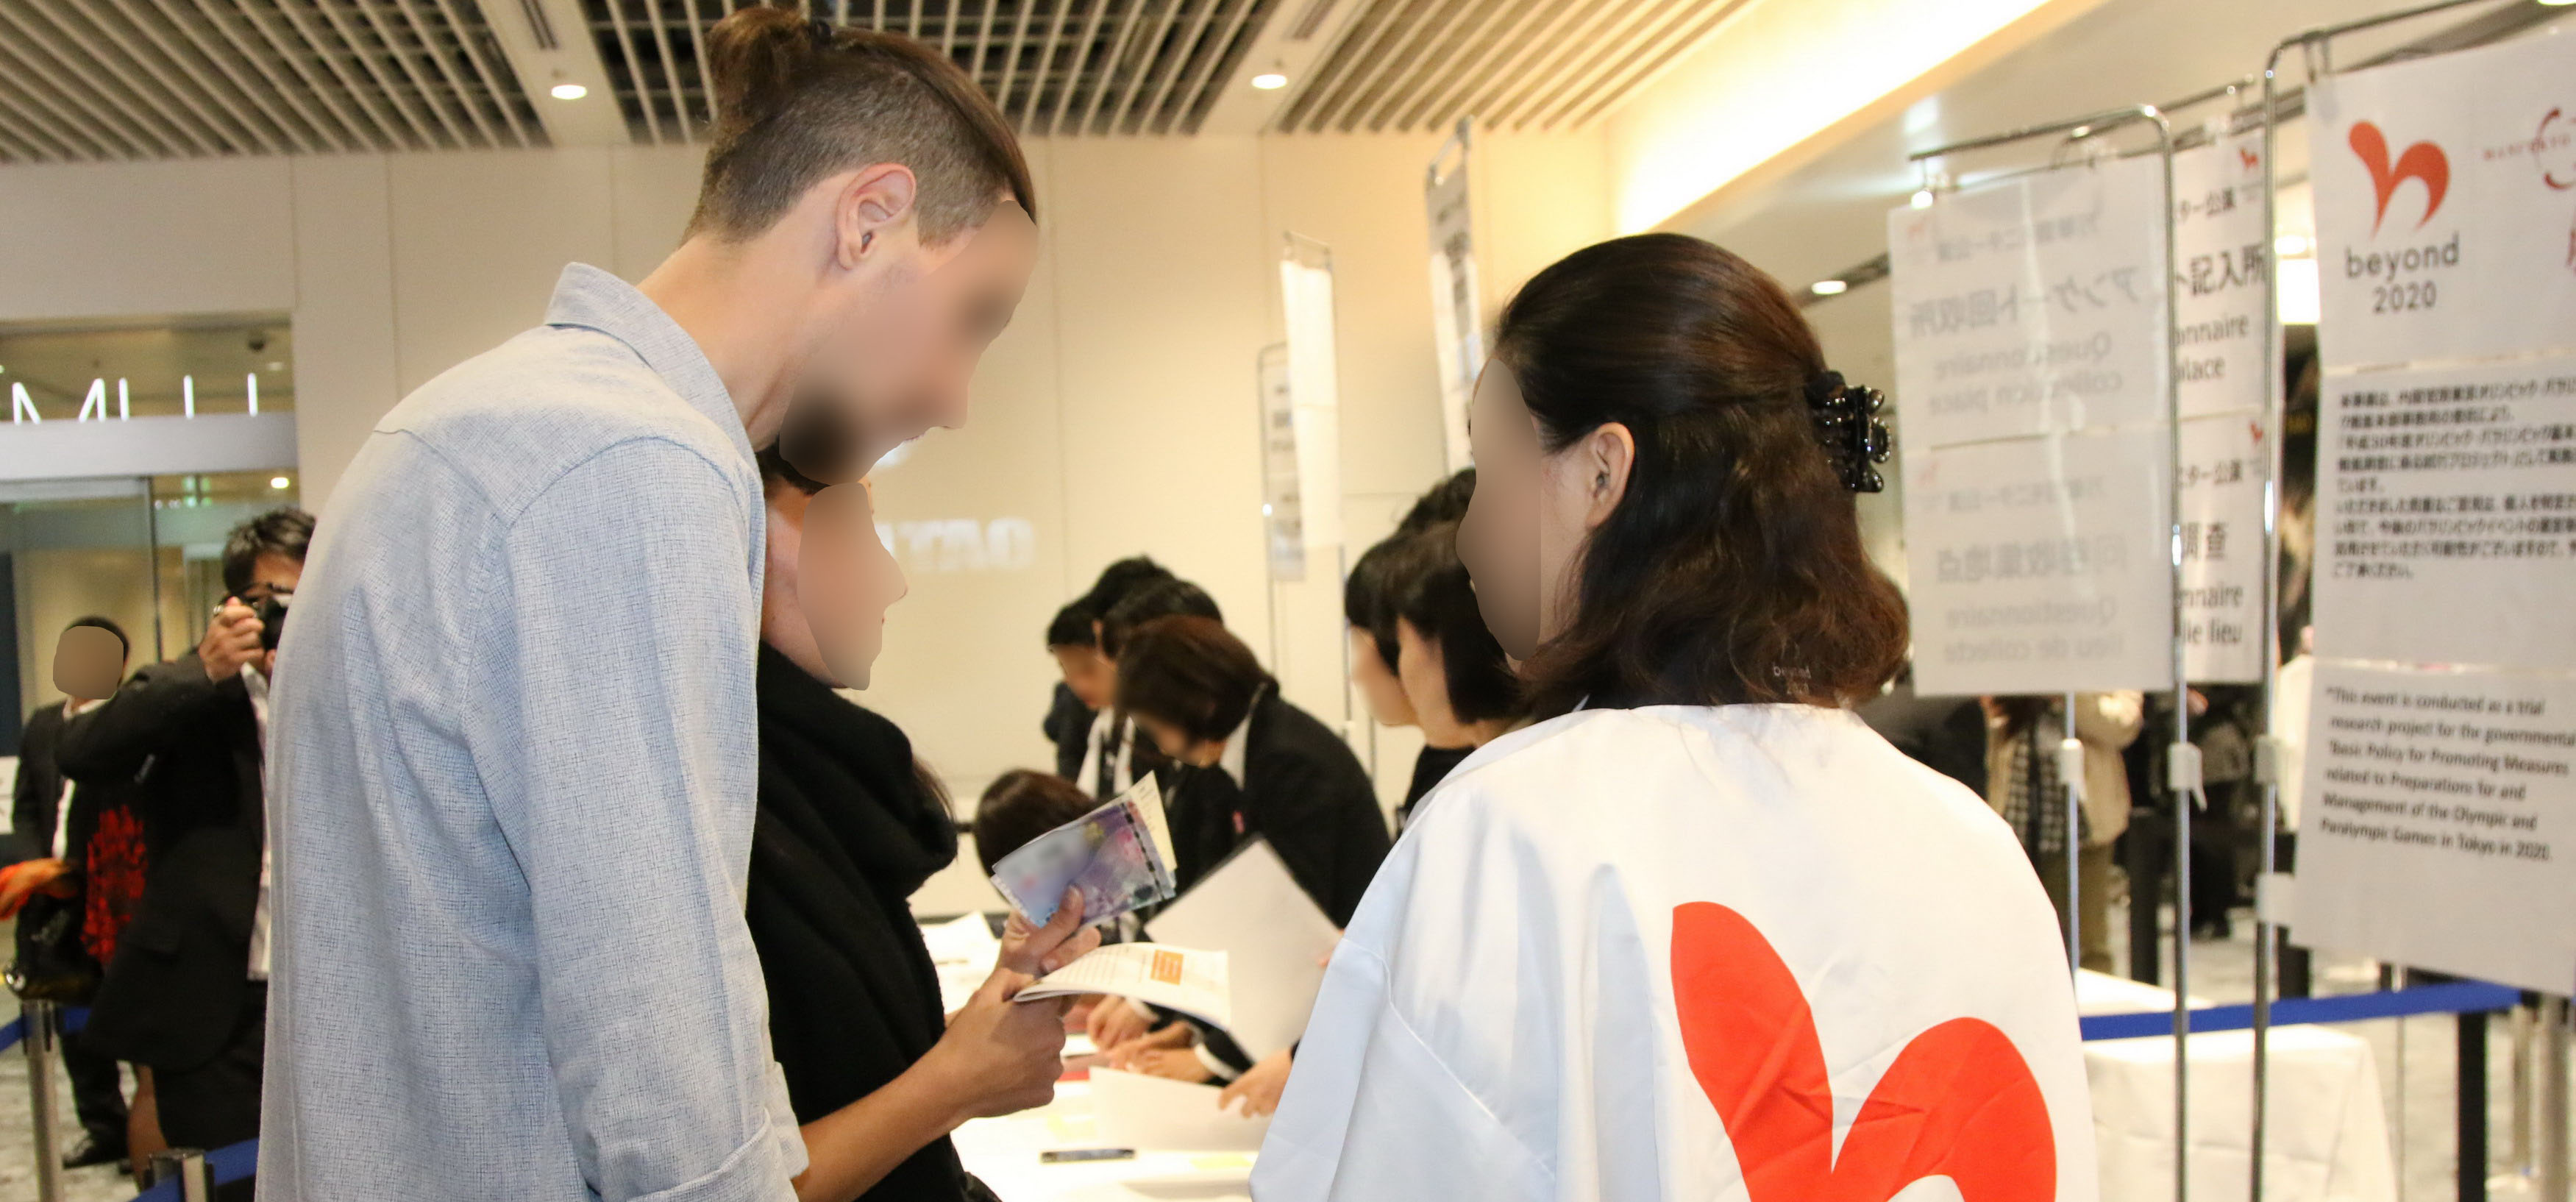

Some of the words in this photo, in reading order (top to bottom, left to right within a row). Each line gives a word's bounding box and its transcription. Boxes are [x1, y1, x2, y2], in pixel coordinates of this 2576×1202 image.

[2174, 186, 2236, 222] ター公演
[2345, 230, 2460, 282] beyond
[2372, 280, 2438, 315] 2020
[2209, 618, 2242, 644] lieu
[2360, 691, 2397, 706] event
[2416, 691, 2485, 714] conducted
[2329, 715, 2382, 732] research
[2387, 719, 2433, 739] project
[2366, 742, 2405, 764] Policy
[2409, 745, 2426, 762] for
[2430, 747, 2499, 774] Promoting
[2504, 753, 2569, 778] Measures
[2325, 767, 2370, 785] related
[2391, 770, 2472, 794] Preparations
[2500, 781, 2526, 801] and
[2322, 792, 2407, 816] Management
[2412, 801, 2425, 817] of
[2453, 804, 2506, 828] Olympic
[2511, 812, 2538, 831] and
[2319, 816, 2388, 842] Paralympic
[2393, 824, 2437, 844] Games
[2457, 832, 2496, 856] Tokyo
